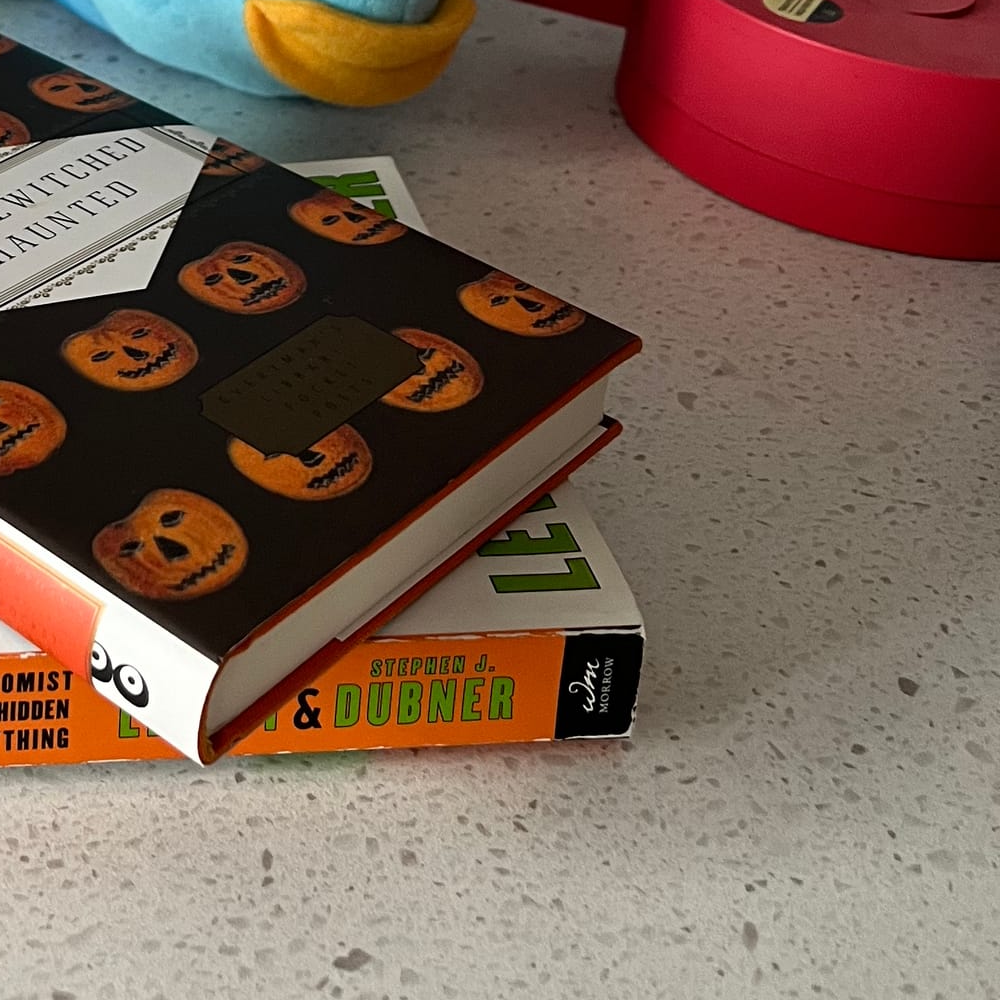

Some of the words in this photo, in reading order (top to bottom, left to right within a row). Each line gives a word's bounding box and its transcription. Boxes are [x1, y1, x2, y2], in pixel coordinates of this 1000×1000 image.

[370, 655, 466, 678] STEPHEN
[474, 653, 496, 673] J.
[598, 656, 615, 713] MORROW
[292, 688, 322, 730] &
[333, 676, 515, 729] DUBNER
